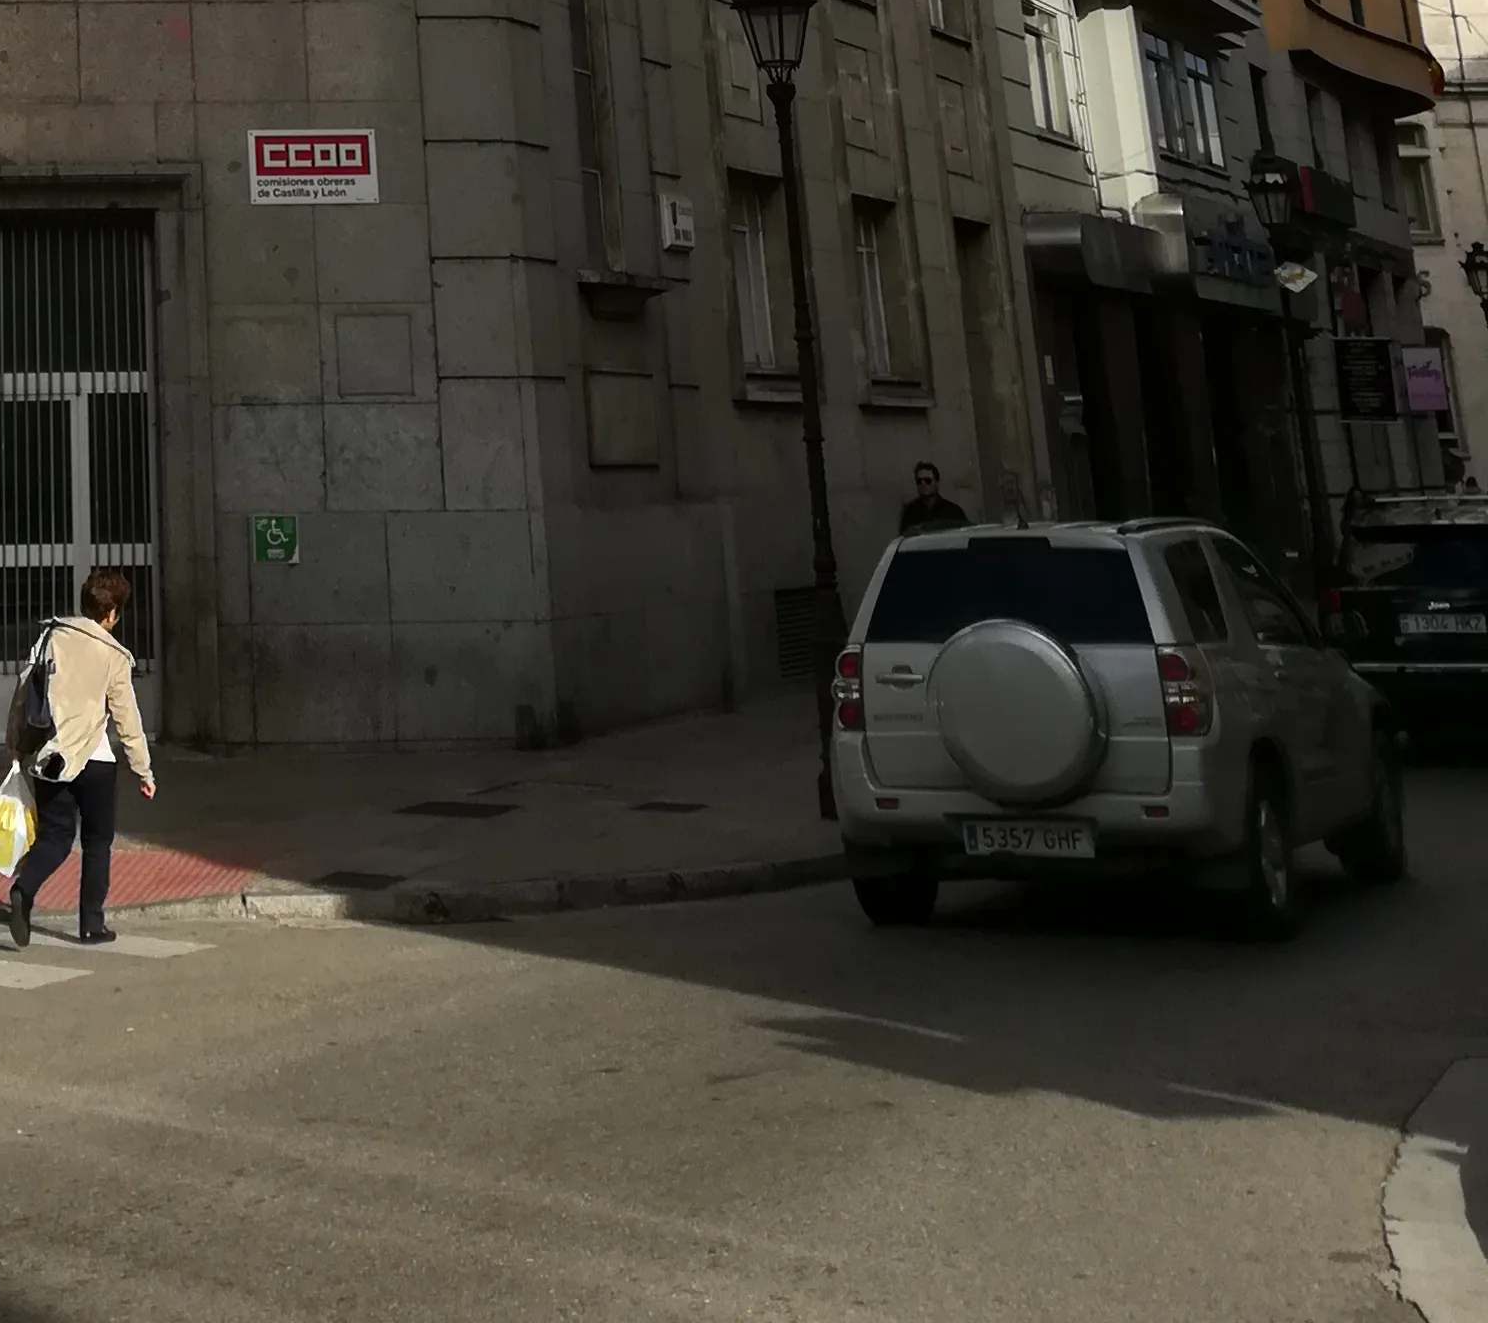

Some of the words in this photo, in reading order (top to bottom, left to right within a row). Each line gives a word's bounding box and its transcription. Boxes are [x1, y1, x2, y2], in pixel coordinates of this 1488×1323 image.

[263, 143, 363, 167] CCOO
[257, 177, 314, 187] comisiones
[317, 177, 356, 187] obreras
[257, 188, 270, 198] de
[273, 188, 310, 198] Castilla
[313, 190, 319, 199] y
[321, 188, 347, 198] León
[982, 826, 1034, 849] 5357
[1043, 829, 1083, 850] GHF
